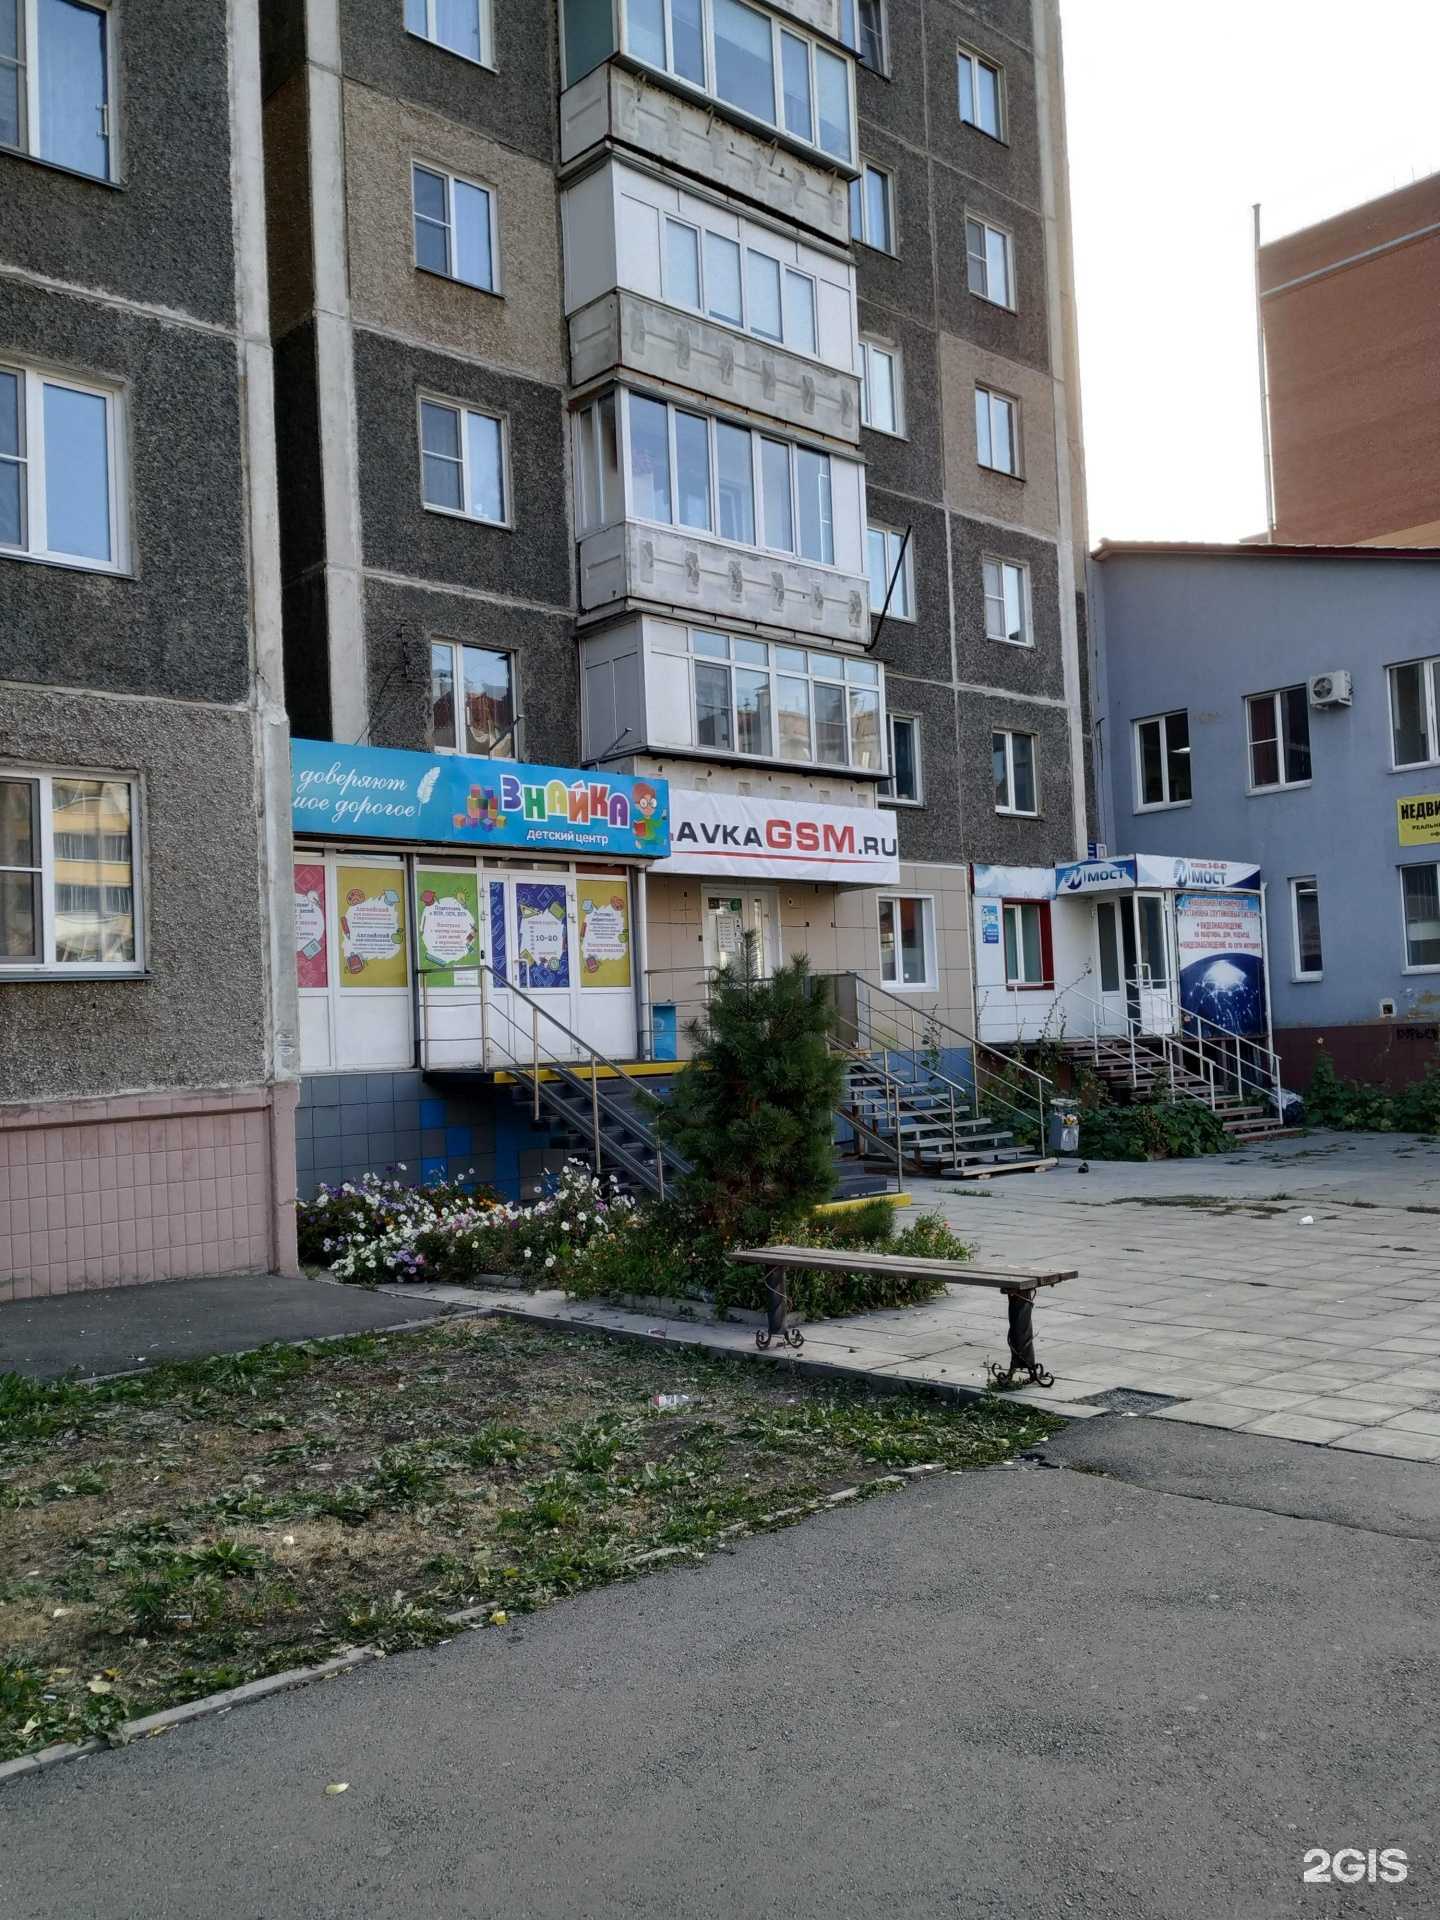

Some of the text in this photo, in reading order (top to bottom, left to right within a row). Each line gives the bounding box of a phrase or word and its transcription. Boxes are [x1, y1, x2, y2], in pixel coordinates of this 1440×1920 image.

[296, 761, 407, 795] доверяют
[331, 795, 416, 823] дорогое
[500, 774, 630, 828] ЗНАЙКА
[527, 829, 609, 845] детский центр
[670, 819, 896, 857] AVKAGSM.RU
[1088, 867, 1126, 882] МОСТ
[1191, 870, 1227, 885] МОСТ
